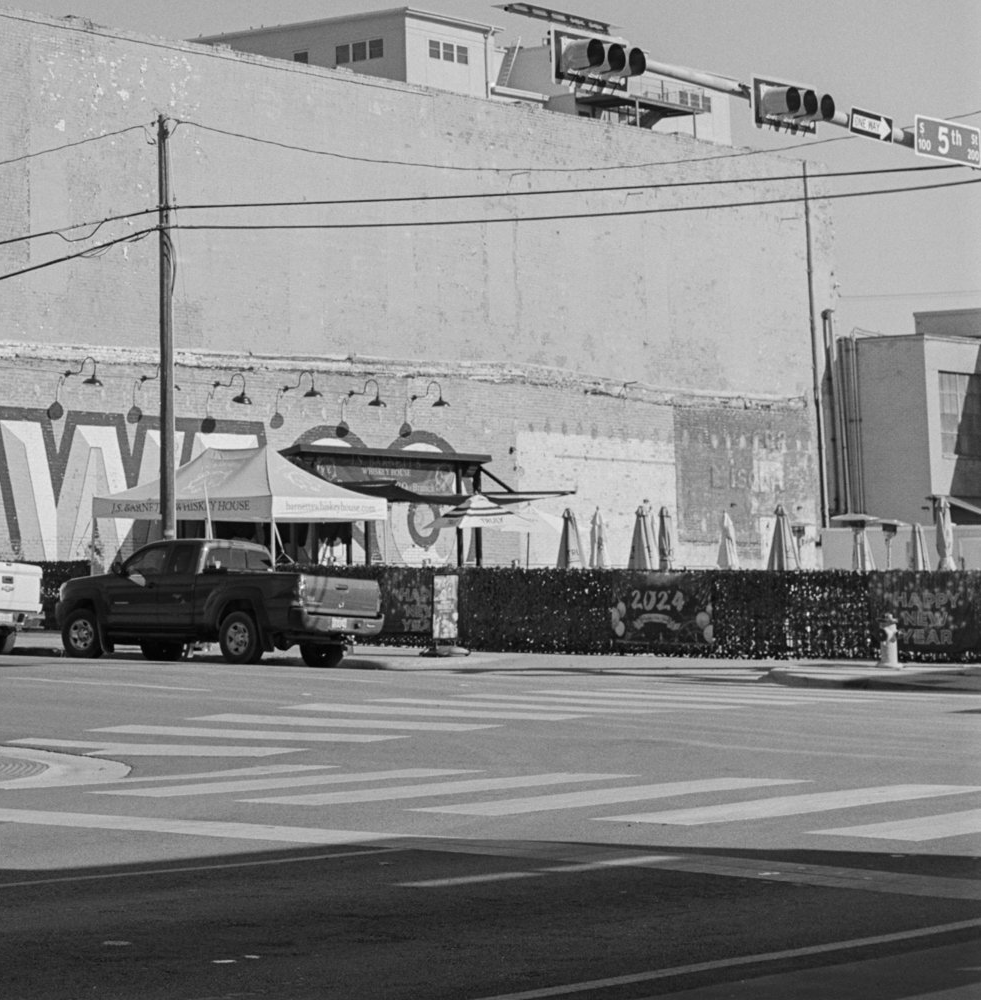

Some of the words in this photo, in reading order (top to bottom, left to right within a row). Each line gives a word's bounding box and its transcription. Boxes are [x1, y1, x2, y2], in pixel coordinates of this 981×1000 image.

[855, 117, 866, 127] ONE
[867, 121, 880, 131] WAY
[919, 122, 925, 134] S
[938, 126, 962, 155] 5th
[918, 139, 931, 151] 100
[967, 149, 979, 161] 200
[218, 500, 250, 511] HOUSE
[631, 589, 685, 612] 2024
[893, 591, 959, 609] HAPPY
[901, 611, 948, 628] NEW
[900, 628, 953, 645] YEAR
